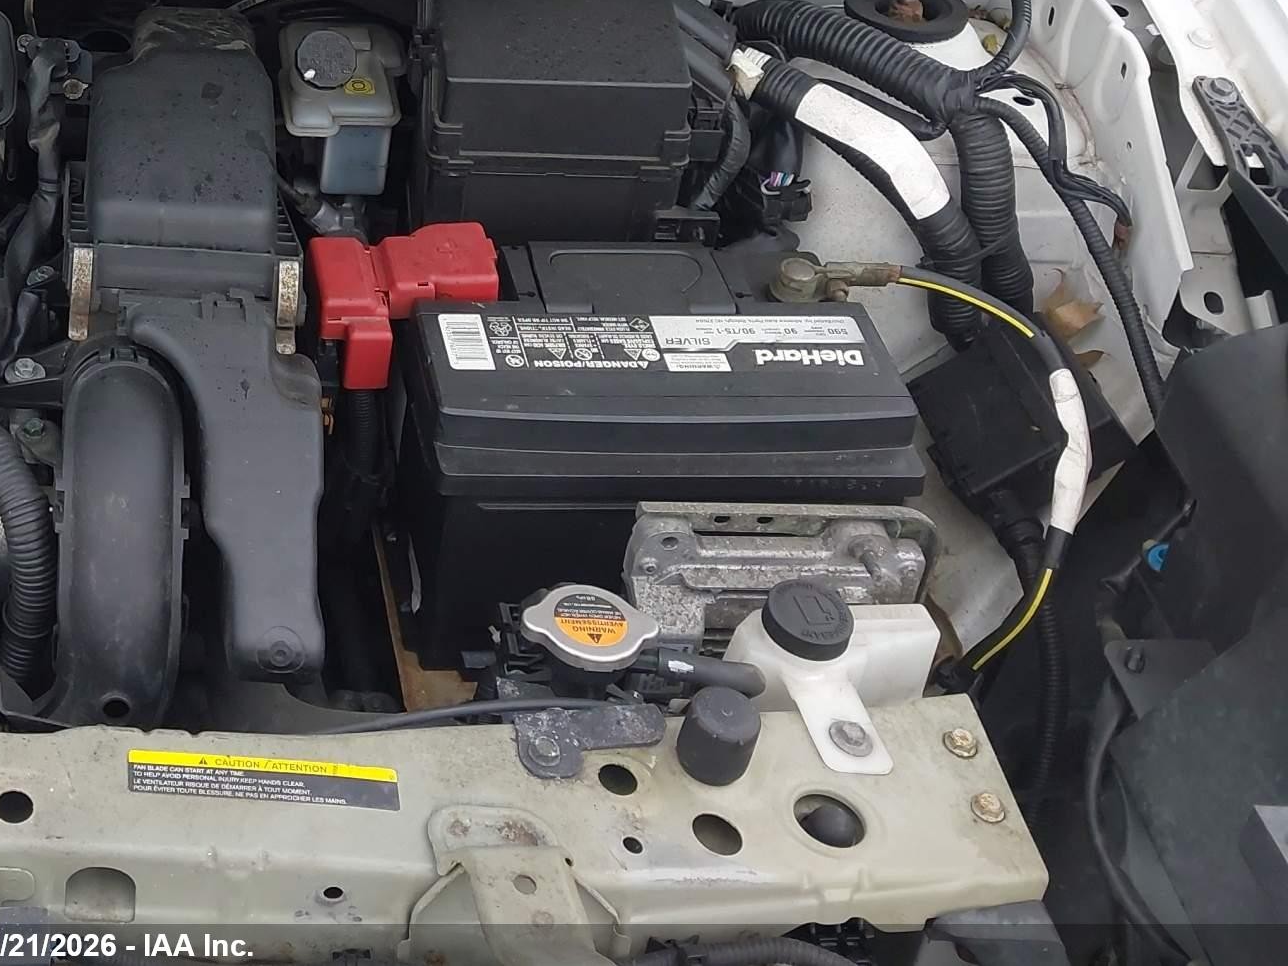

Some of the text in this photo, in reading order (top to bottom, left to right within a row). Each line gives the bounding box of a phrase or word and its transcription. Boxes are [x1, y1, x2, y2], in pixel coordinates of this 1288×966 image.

[754, 349, 864, 366] DieHard
[560, 619, 623, 628] AVERTISSEMENT
[572, 626, 616, 634] WARNING
[215, 758, 260, 768] CAUTION
[271, 762, 327, 773] ATTENTION
[183, 774, 216, 782] PERSONAL
[143, 779, 183, 787] VENTILATEUR
[221, 782, 257, 791] DÉMARRER
[154, 785, 176, 793] ÉVITER
